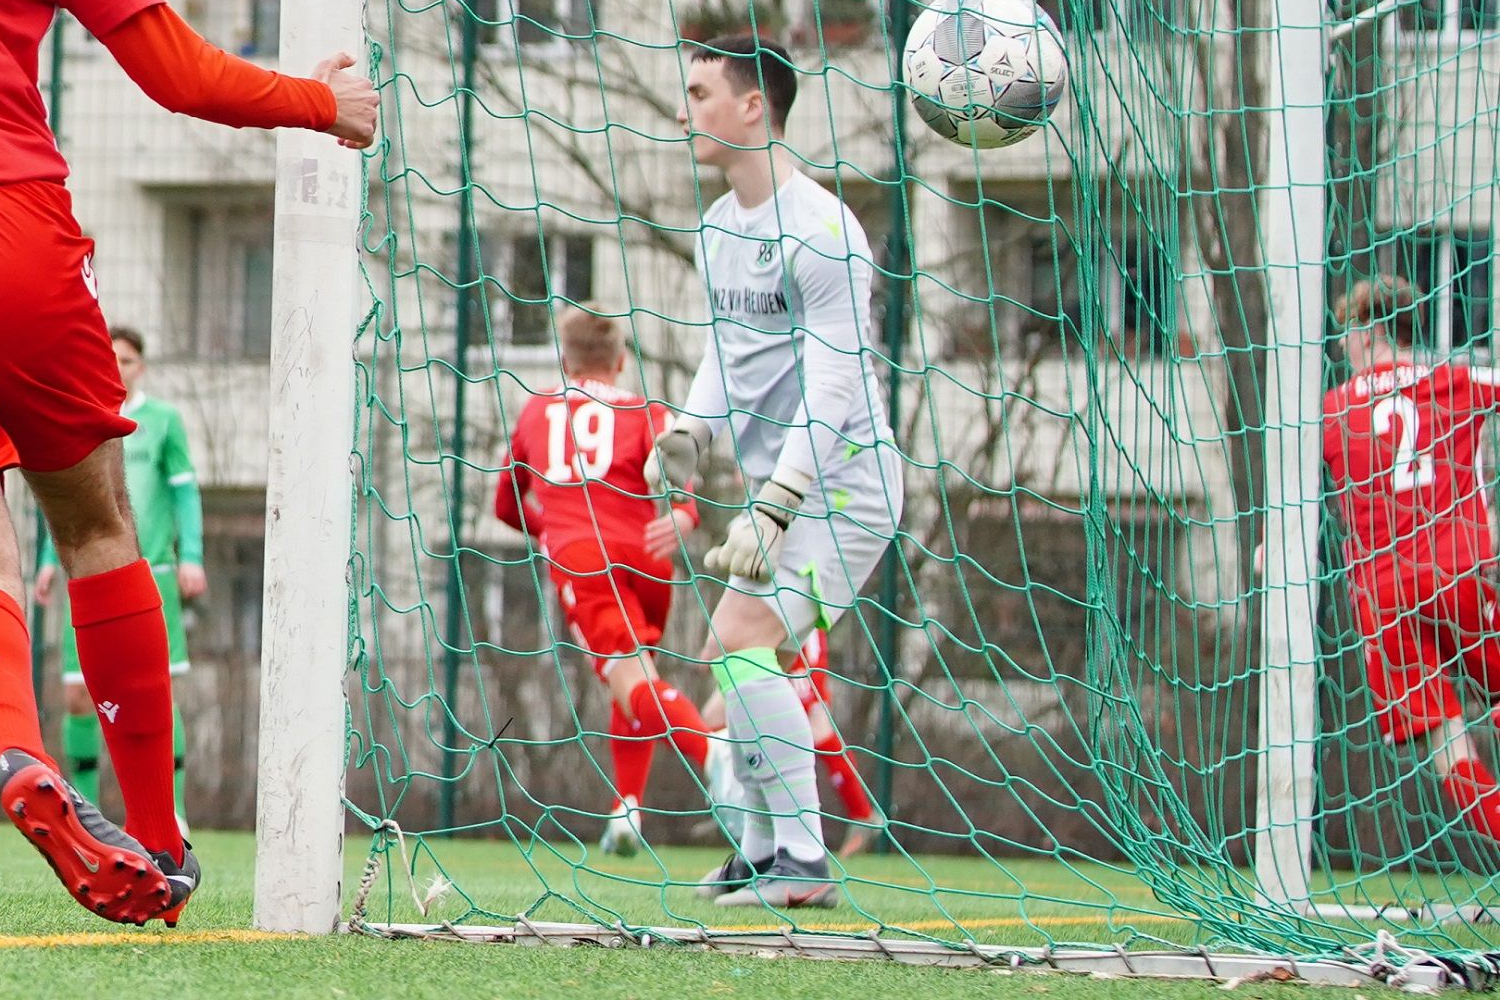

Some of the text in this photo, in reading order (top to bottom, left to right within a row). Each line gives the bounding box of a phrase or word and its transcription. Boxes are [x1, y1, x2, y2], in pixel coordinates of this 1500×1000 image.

[990, 66, 1015, 78] SELECT
[743, 286, 789, 314] HEIDEN
[544, 400, 616, 482] 19
[1372, 395, 1437, 492] 2
